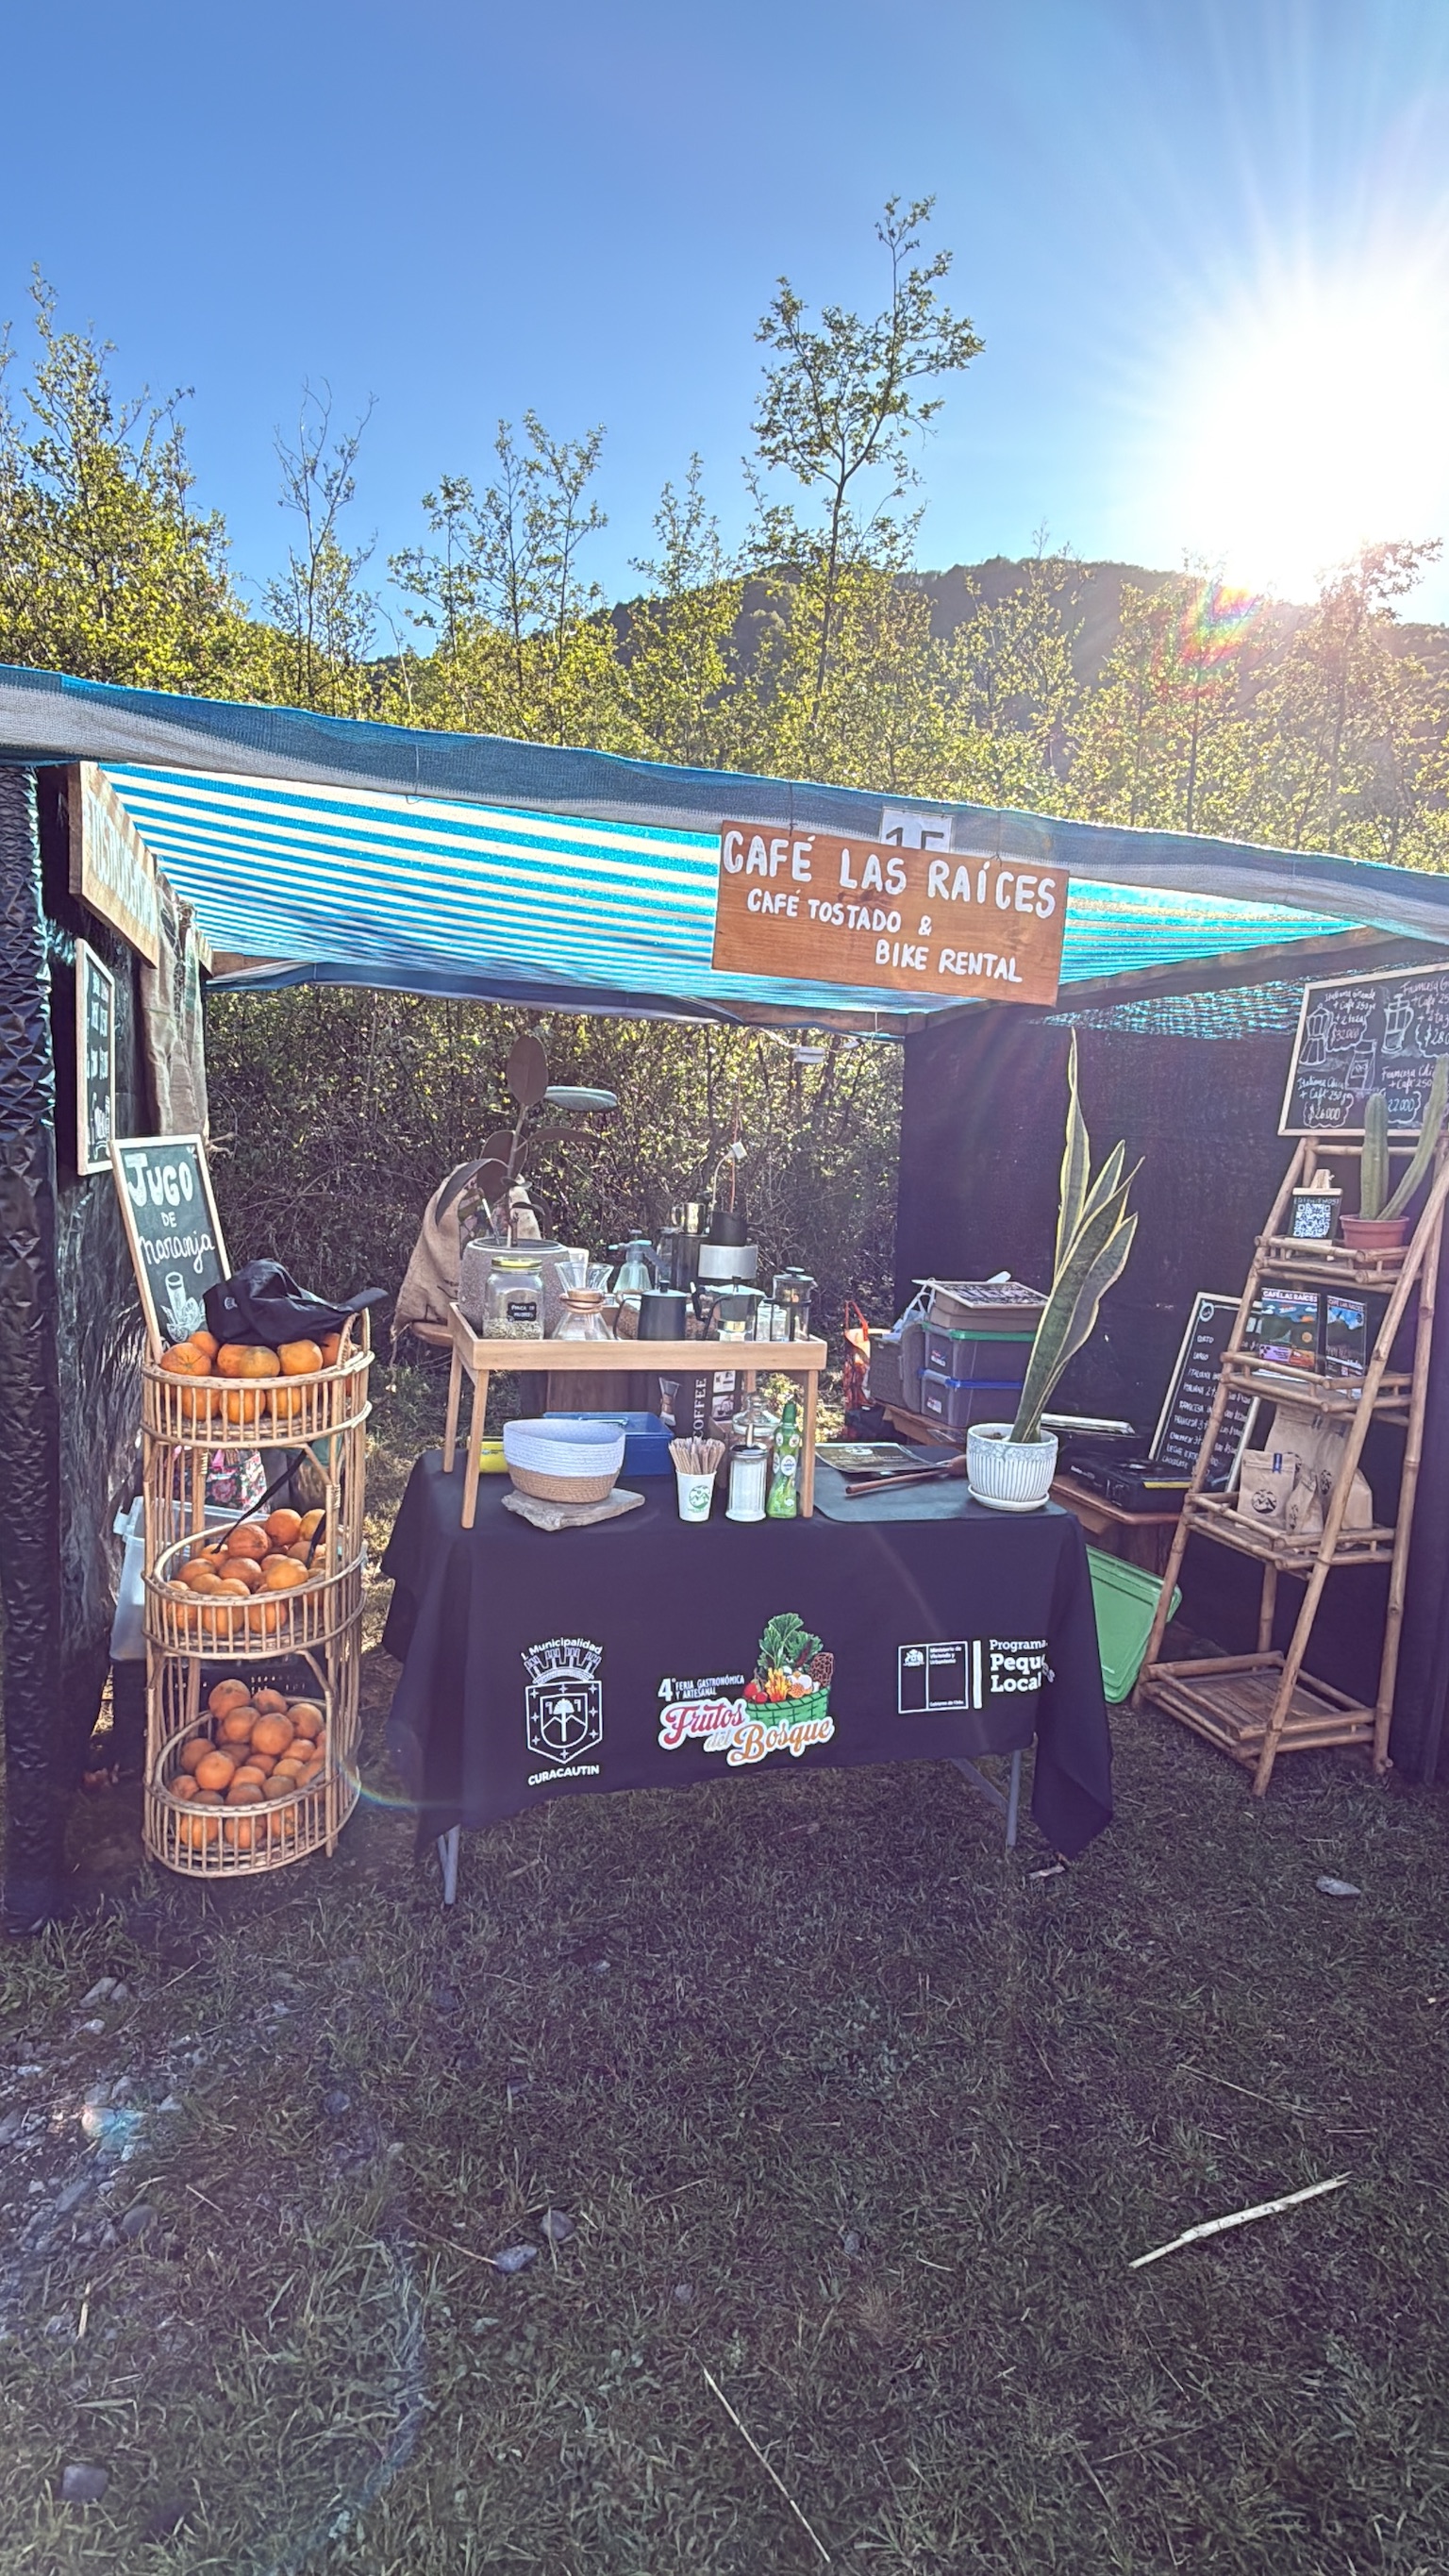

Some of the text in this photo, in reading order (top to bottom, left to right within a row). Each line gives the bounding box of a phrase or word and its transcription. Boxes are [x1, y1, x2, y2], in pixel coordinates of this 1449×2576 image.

[722, 828, 1058, 919] CAFÉ LAS RAÍCES
[747, 888, 933, 936] CAFÉ TOSTADO &
[875, 939, 1024, 982] BIKE RENTAL
[124, 1152, 193, 1208] JUGO
[159, 1211, 177, 1228] DE
[692, 1378, 708, 1439] COFFEE
[528, 1636, 603, 1656] Municipalidad
[675, 1680, 694, 1692] FERIA
[696, 1674, 745, 1688] GASTRONÓMICA
[675, 1686, 718, 1700] Y ARTESANAL
[663, 1702, 746, 1746] Frutos
[730, 1718, 830, 1764] Bosque
[527, 1764, 600, 1786] CURACAUTIN
